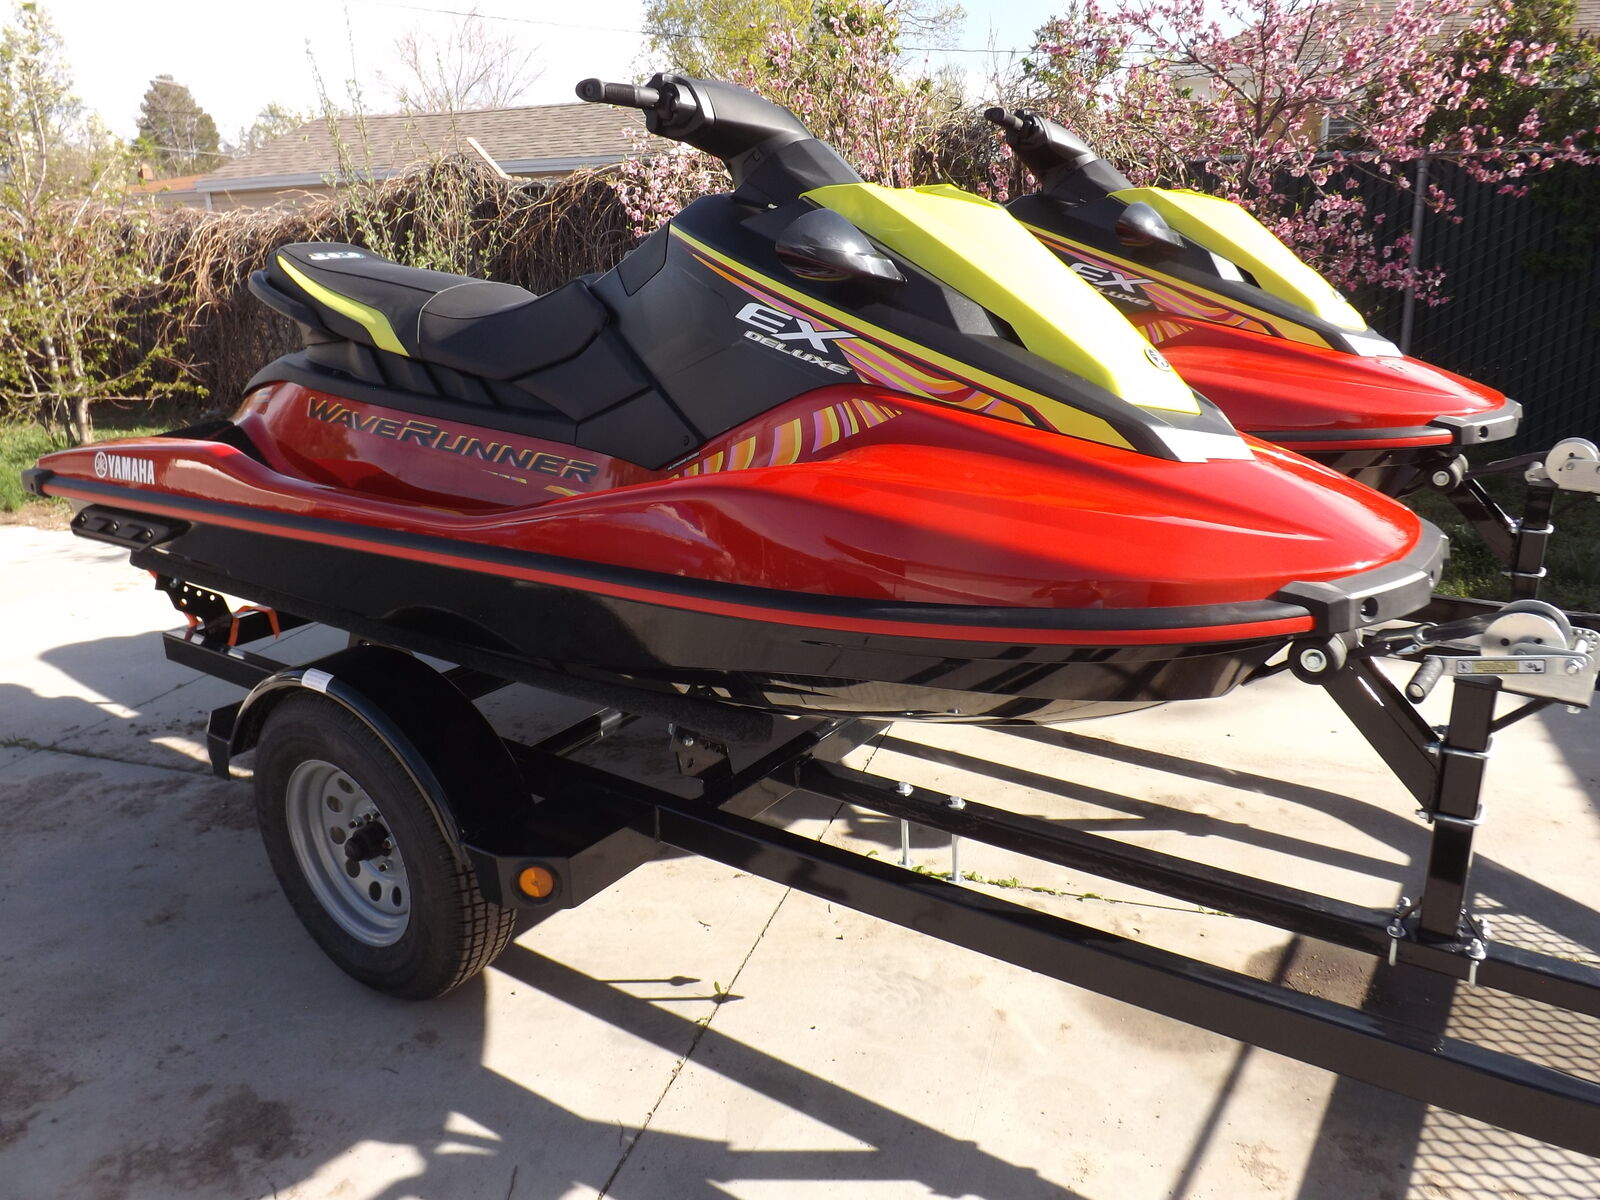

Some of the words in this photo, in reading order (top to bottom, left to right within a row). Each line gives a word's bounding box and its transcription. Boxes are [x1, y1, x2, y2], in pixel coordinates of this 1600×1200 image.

[1069, 262, 1155, 293] EX
[735, 302, 859, 353] EX
[743, 330, 853, 375] DELUXE
[306, 396, 599, 484] WAVERUNNER
[107, 454, 155, 485] YAMAHA
